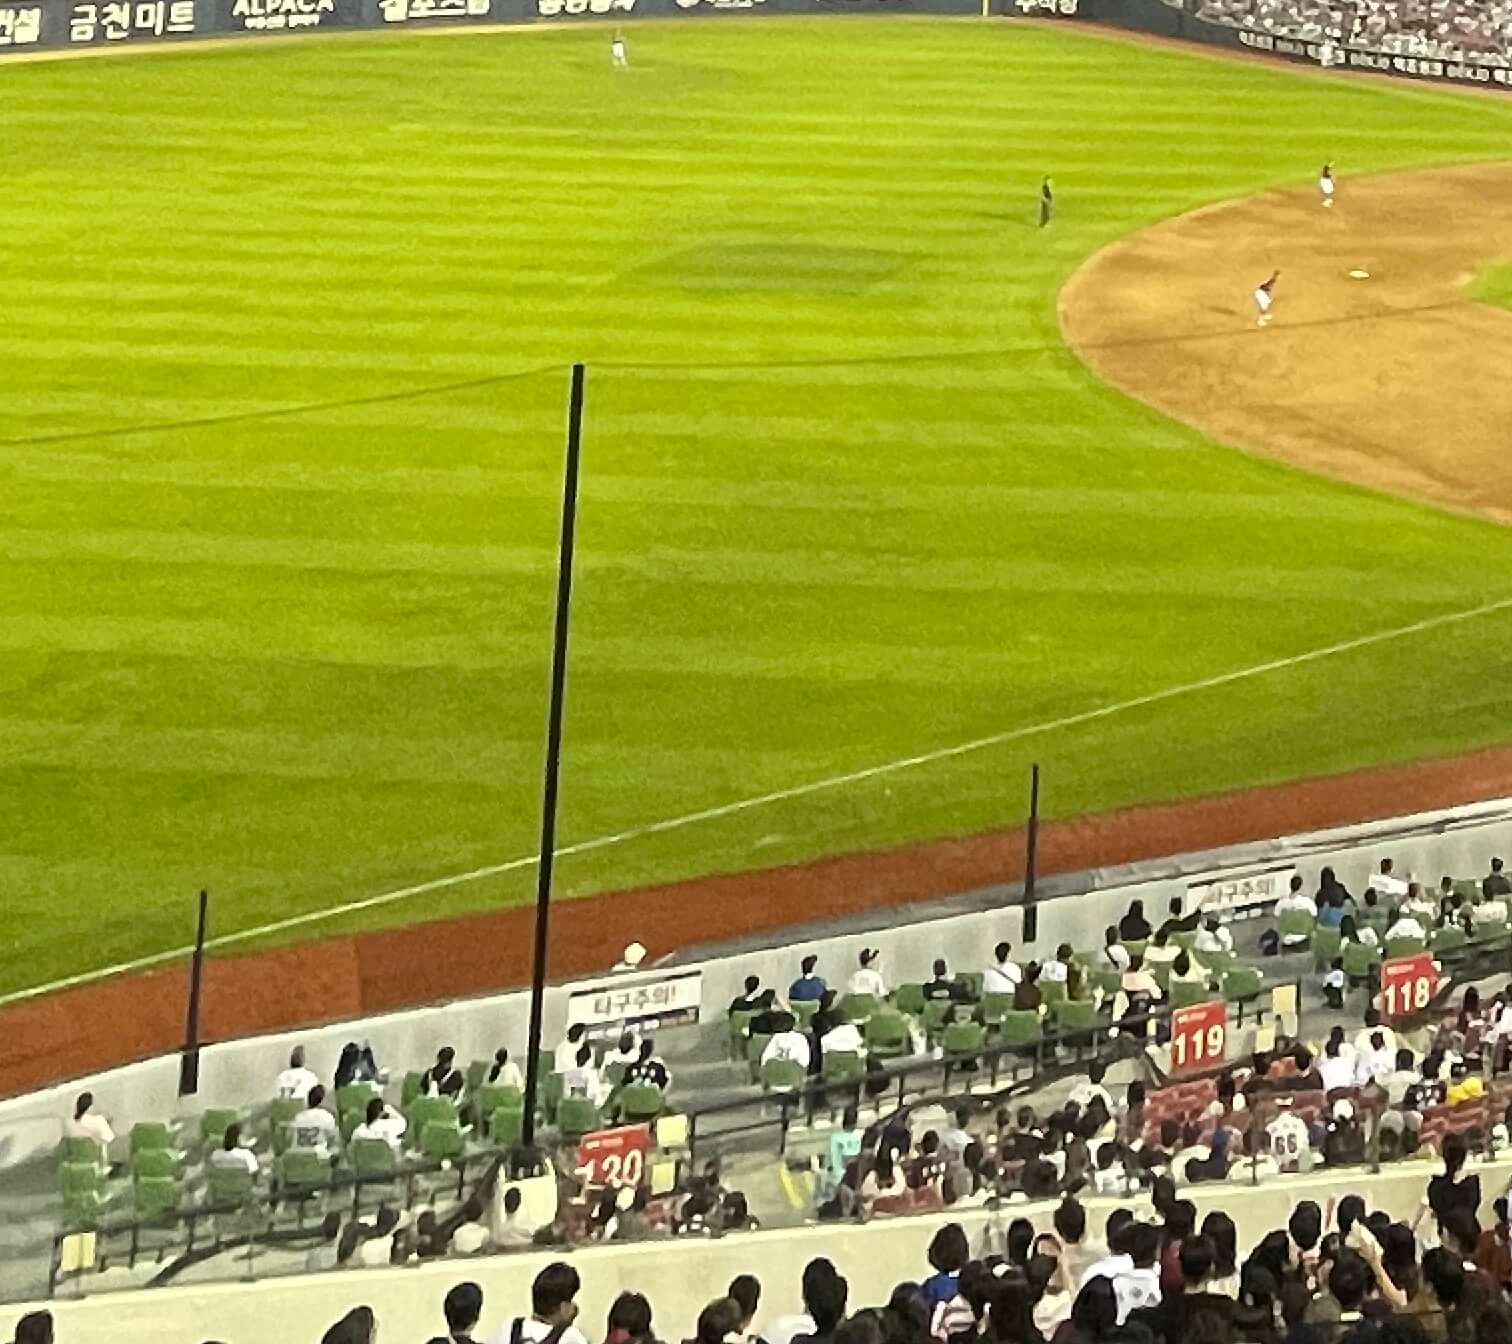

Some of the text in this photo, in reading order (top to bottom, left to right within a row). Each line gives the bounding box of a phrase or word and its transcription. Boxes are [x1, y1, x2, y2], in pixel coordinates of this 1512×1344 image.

[70, 0, 195, 41] 금천미트
[1384, 976, 1431, 1016] 118
[1175, 1024, 1224, 1067] 119
[574, 1147, 642, 1189] 120
